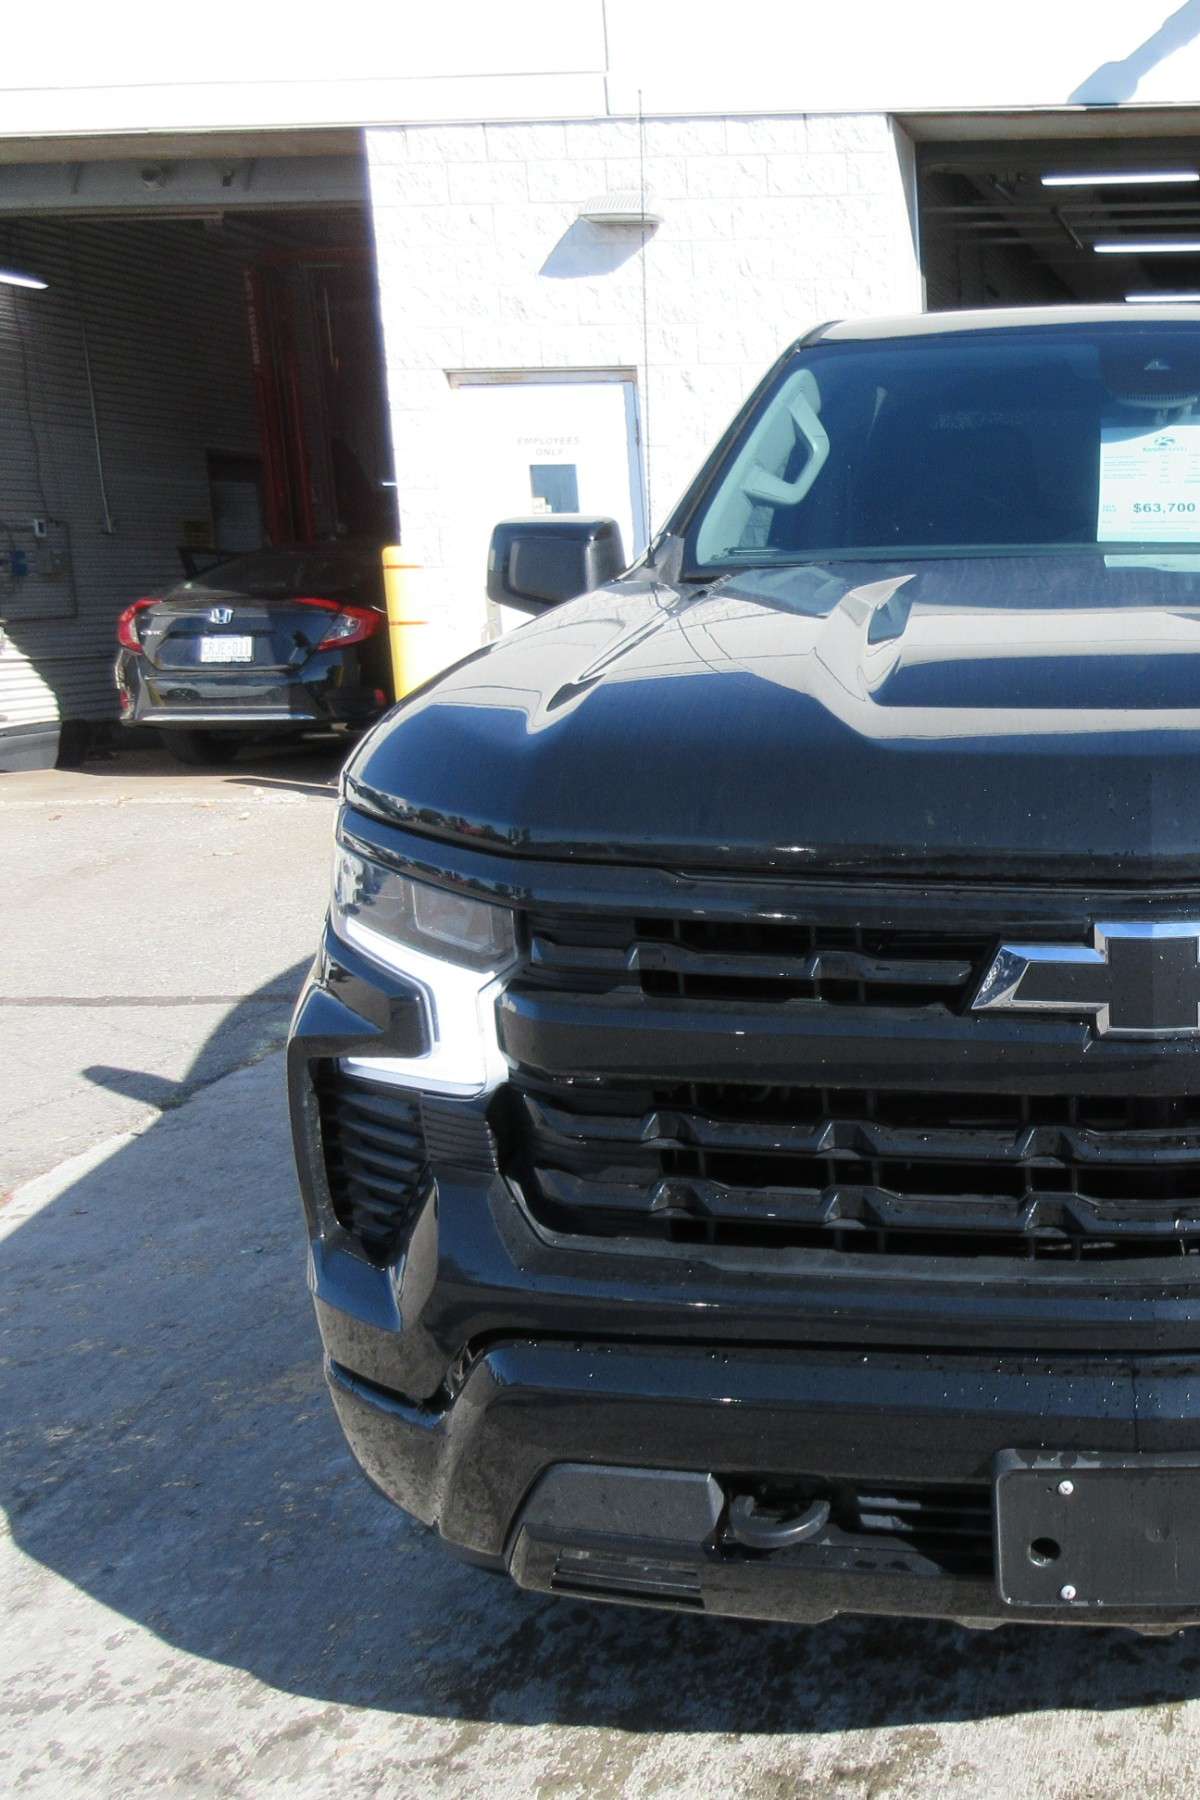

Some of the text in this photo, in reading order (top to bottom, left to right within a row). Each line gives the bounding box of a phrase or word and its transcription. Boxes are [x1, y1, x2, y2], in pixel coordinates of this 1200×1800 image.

[517, 436, 581, 446] EMPLOYEES
[535, 448, 564, 457] ONLY
[1133, 502, 1196, 514] $63,700
